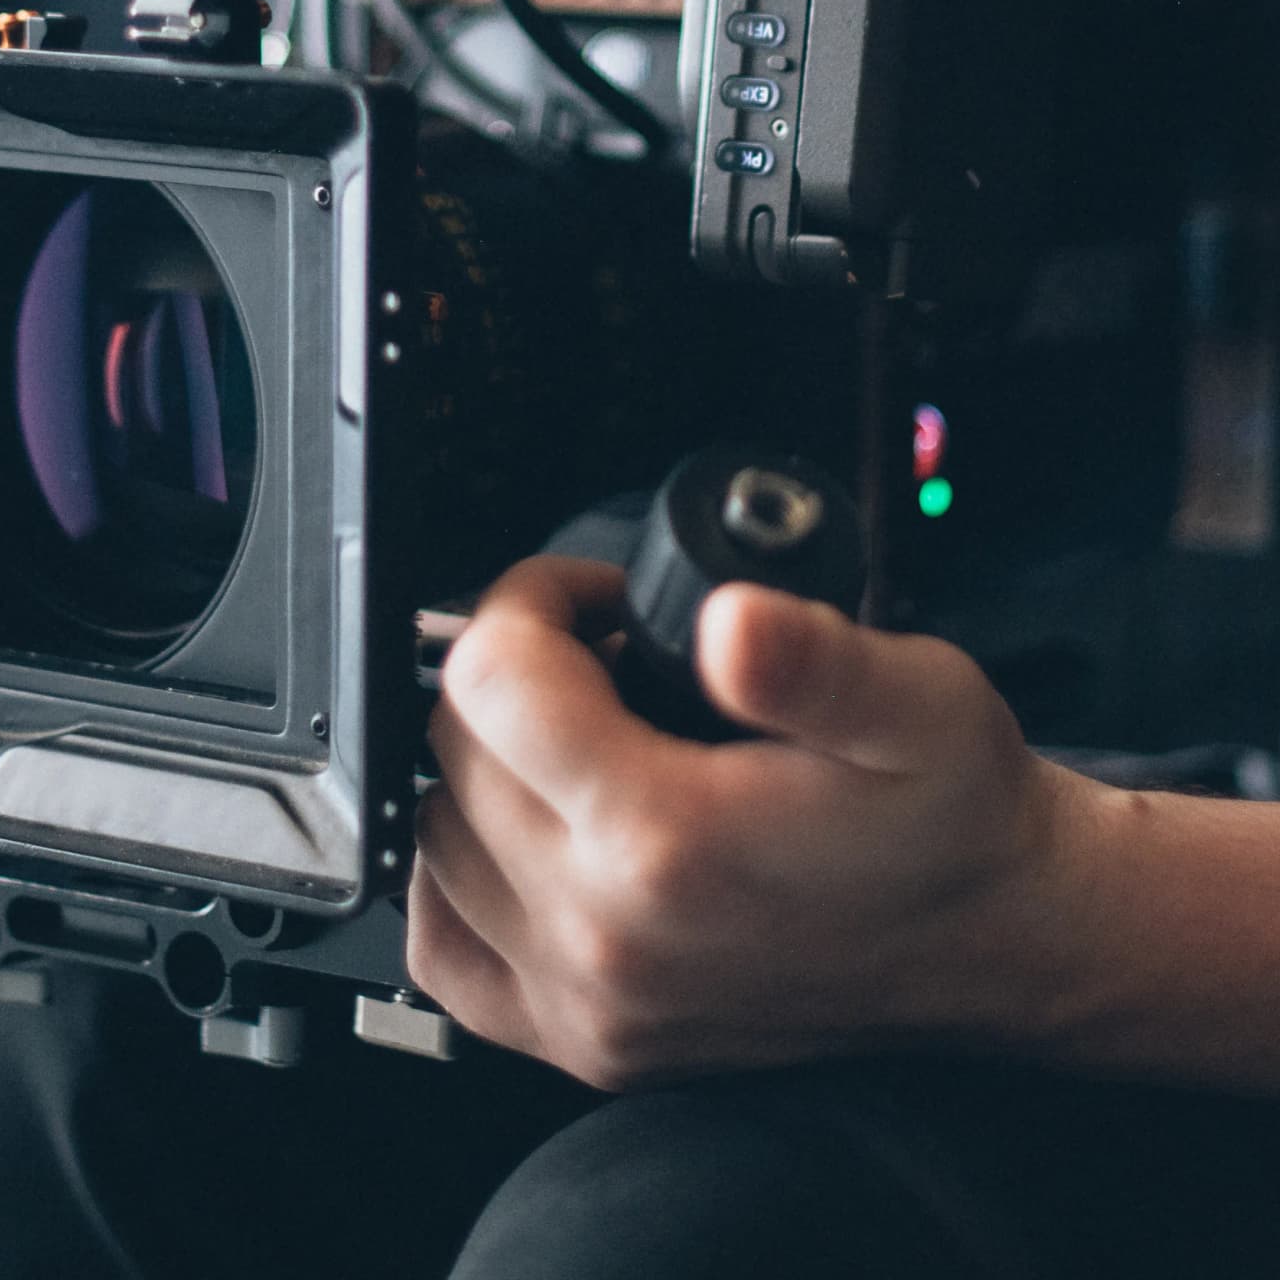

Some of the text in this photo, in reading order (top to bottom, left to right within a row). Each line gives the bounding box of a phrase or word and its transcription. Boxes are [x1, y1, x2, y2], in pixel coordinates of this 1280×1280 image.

[747, 22, 774, 39] VF1
[740, 86, 769, 104] EXP
[741, 151, 763, 169] PK
